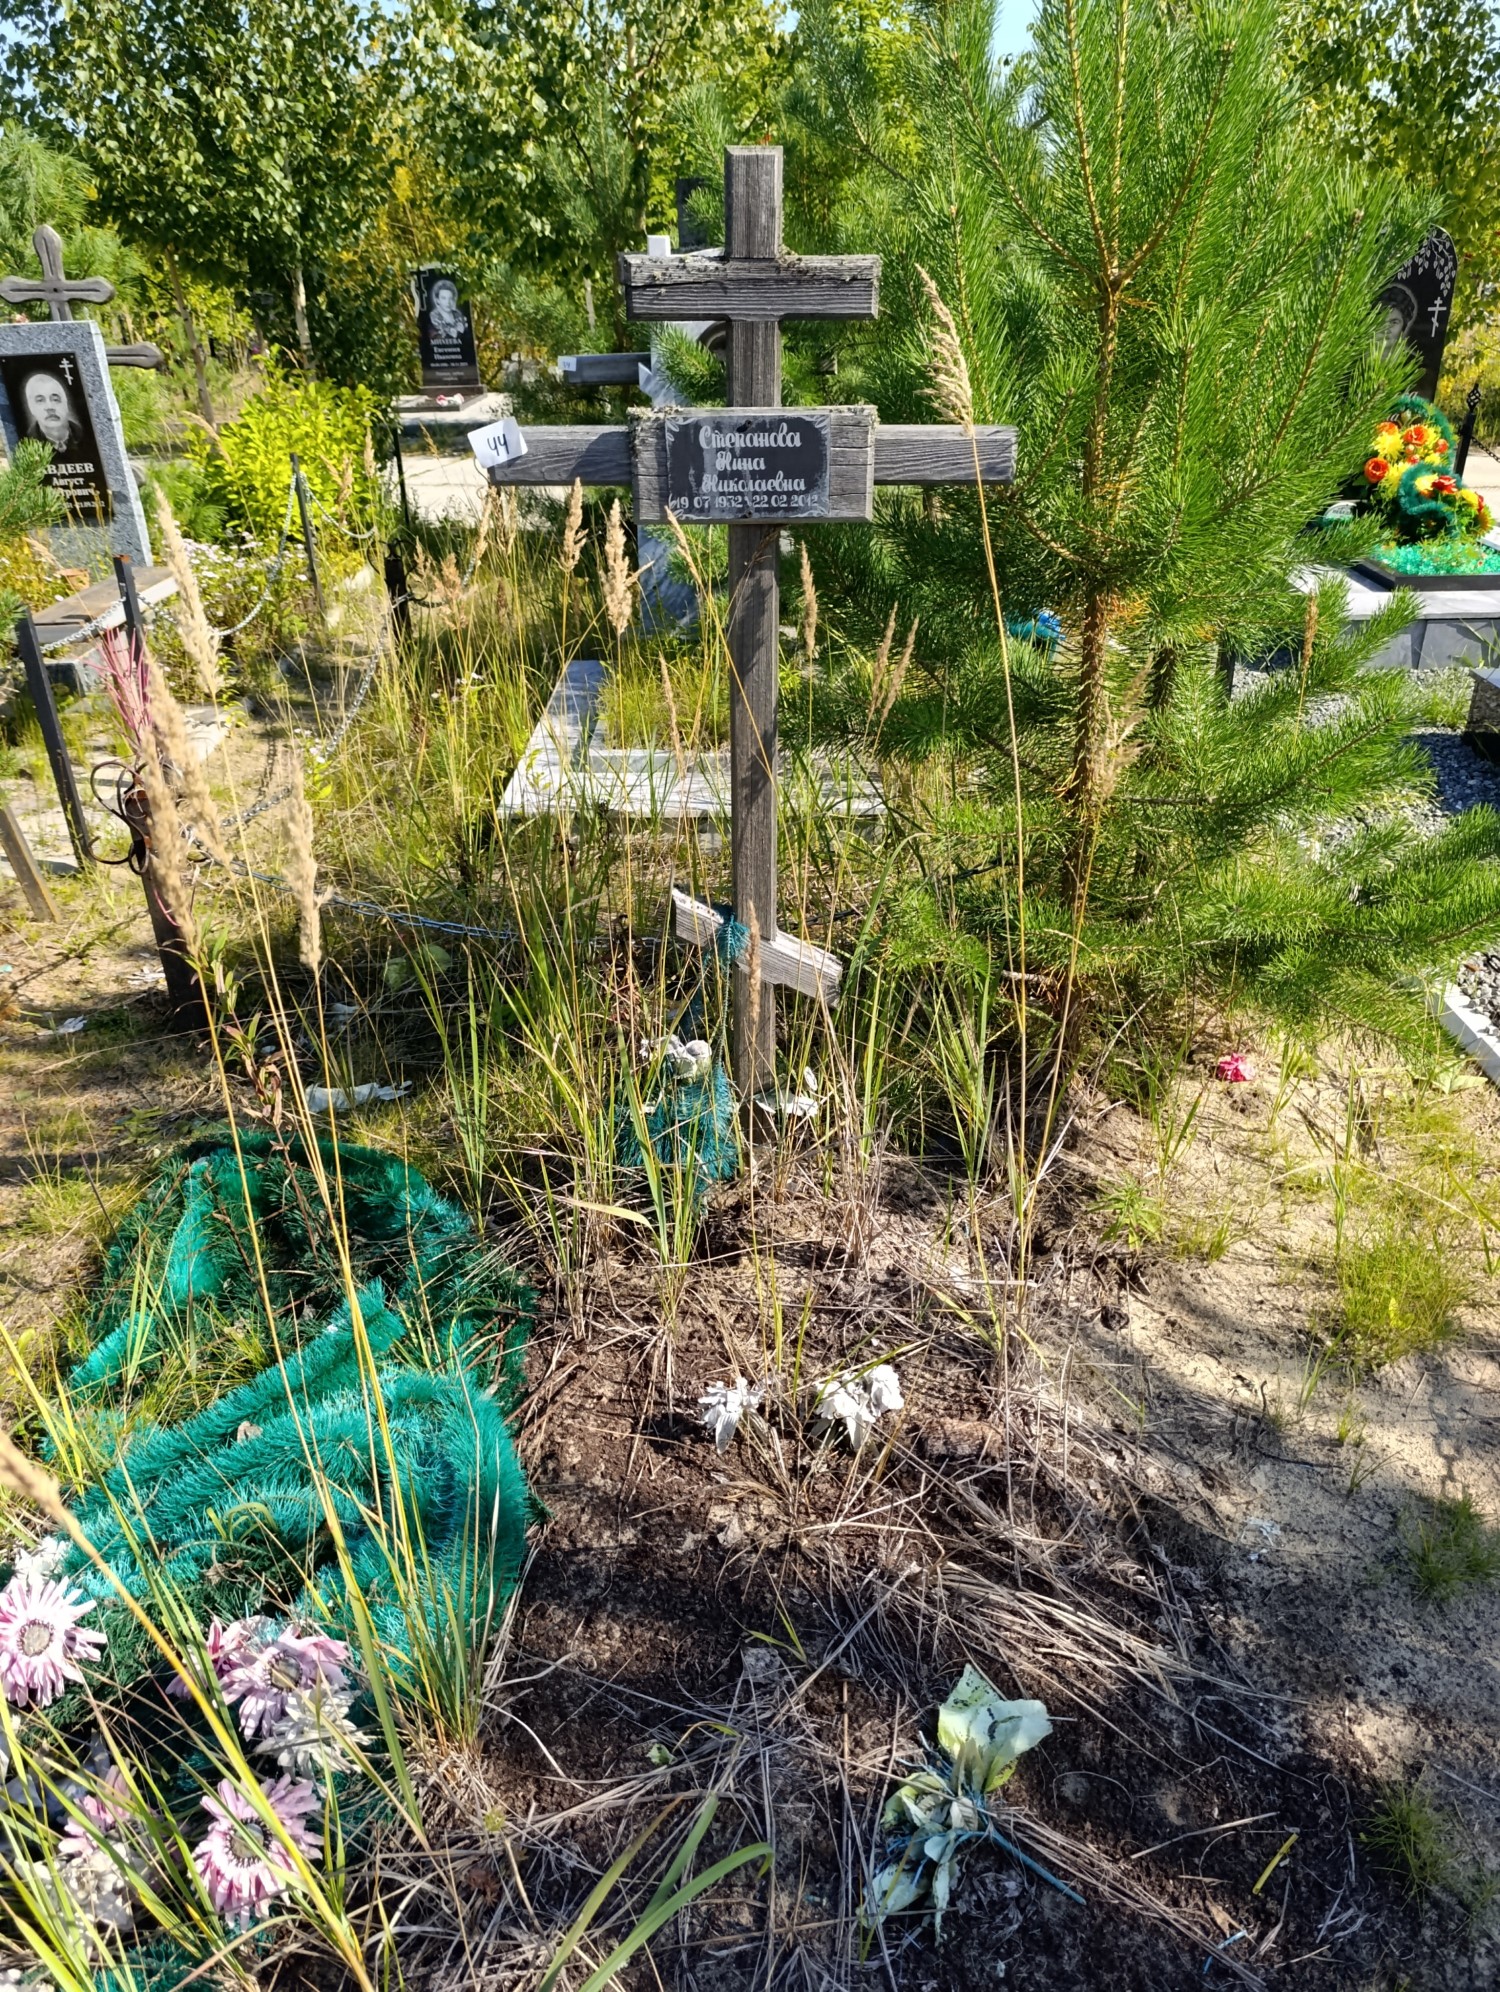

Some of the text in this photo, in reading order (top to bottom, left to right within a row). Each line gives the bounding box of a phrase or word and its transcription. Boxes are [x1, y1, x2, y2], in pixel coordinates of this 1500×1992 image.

[487, 433, 510, 457] 44
[699, 422, 802, 449] Степанова
[715, 450, 767, 471] Нина
[701, 470, 807, 493] Николаевна
[676, 496, 690, 509] 19
[693, 496, 711, 509] 07
[752, 494, 769, 507] 22
[770, 494, 788, 507] 02
[790, 494, 819, 507] 2012
